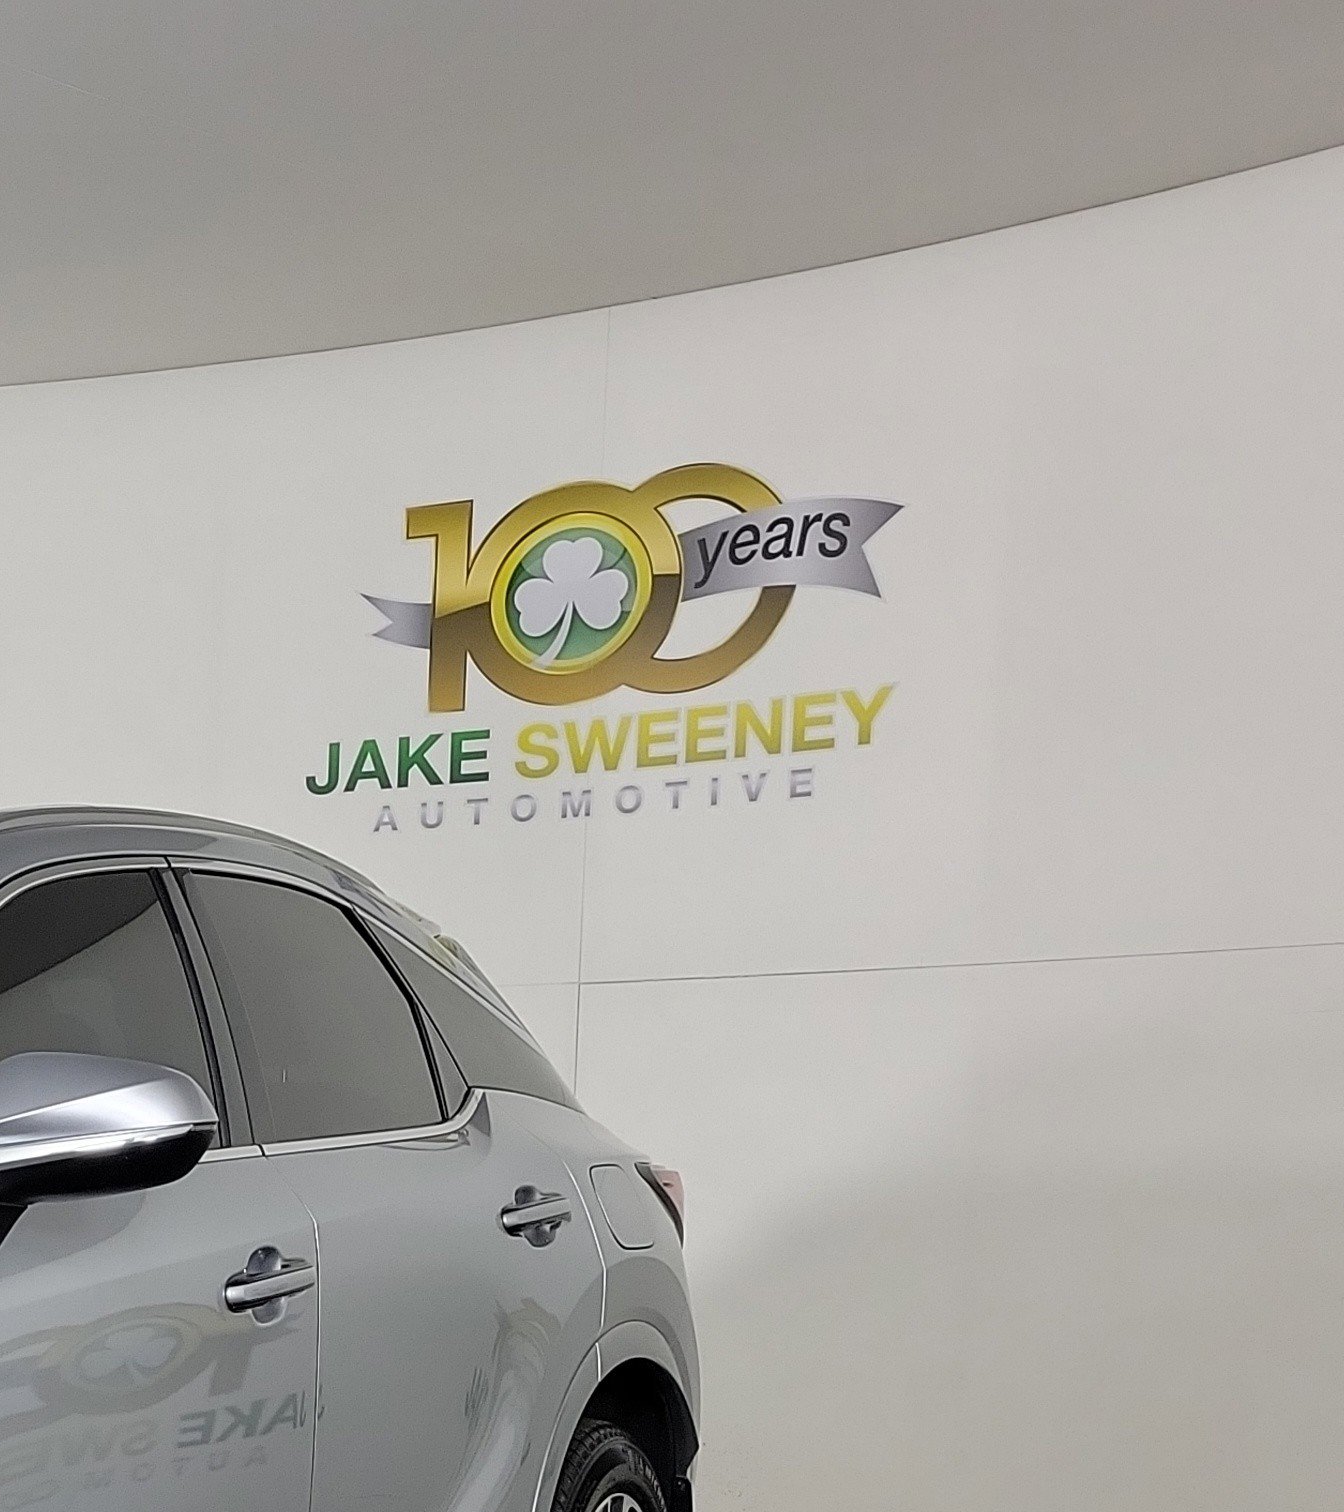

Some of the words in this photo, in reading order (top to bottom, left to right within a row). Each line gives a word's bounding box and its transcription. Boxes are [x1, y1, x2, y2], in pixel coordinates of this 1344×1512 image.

[694, 509, 851, 590] years
[305, 729, 491, 796] JAKE
[514, 684, 896, 779] SWEENEY
[373, 768, 814, 833] AUTOMOTIVE
